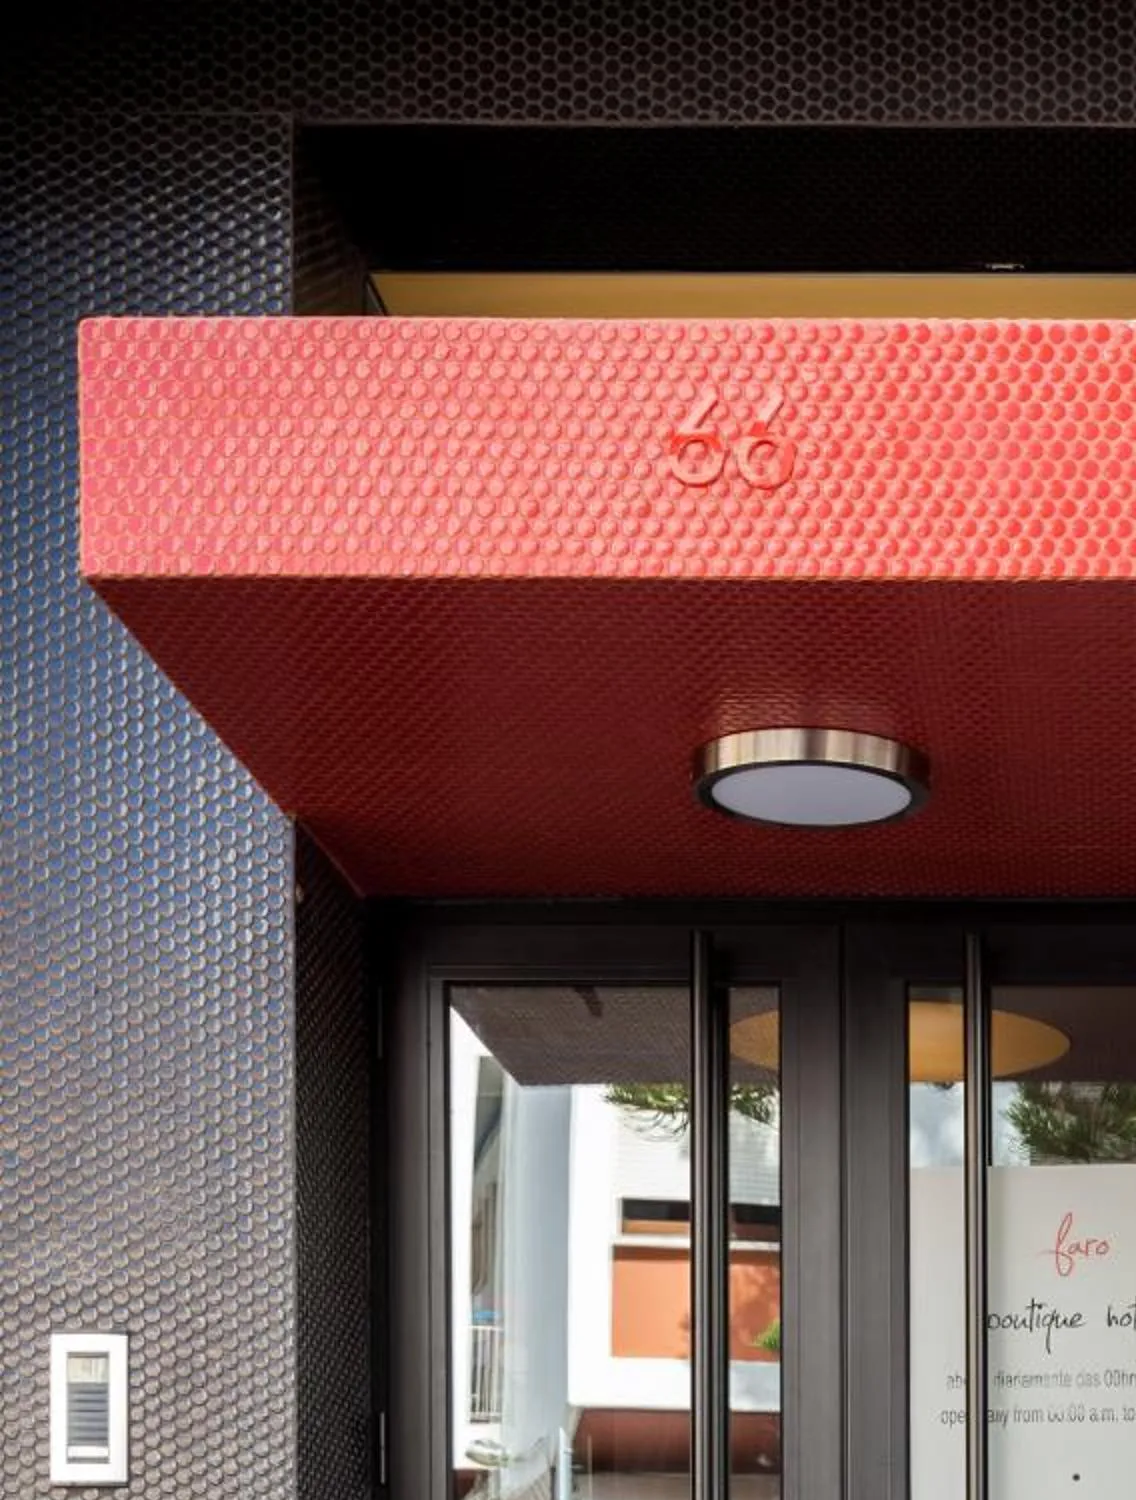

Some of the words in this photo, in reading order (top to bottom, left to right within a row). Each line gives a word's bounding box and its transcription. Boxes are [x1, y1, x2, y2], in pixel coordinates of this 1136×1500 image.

[669, 382, 798, 491] 66
[1037, 1212, 1110, 1277] faro
[1076, 1371, 1101, 1388] das
[940, 1407, 967, 1428] ope
[1013, 1404, 1045, 1422] from
[1122, 1405, 1136, 1421] to
